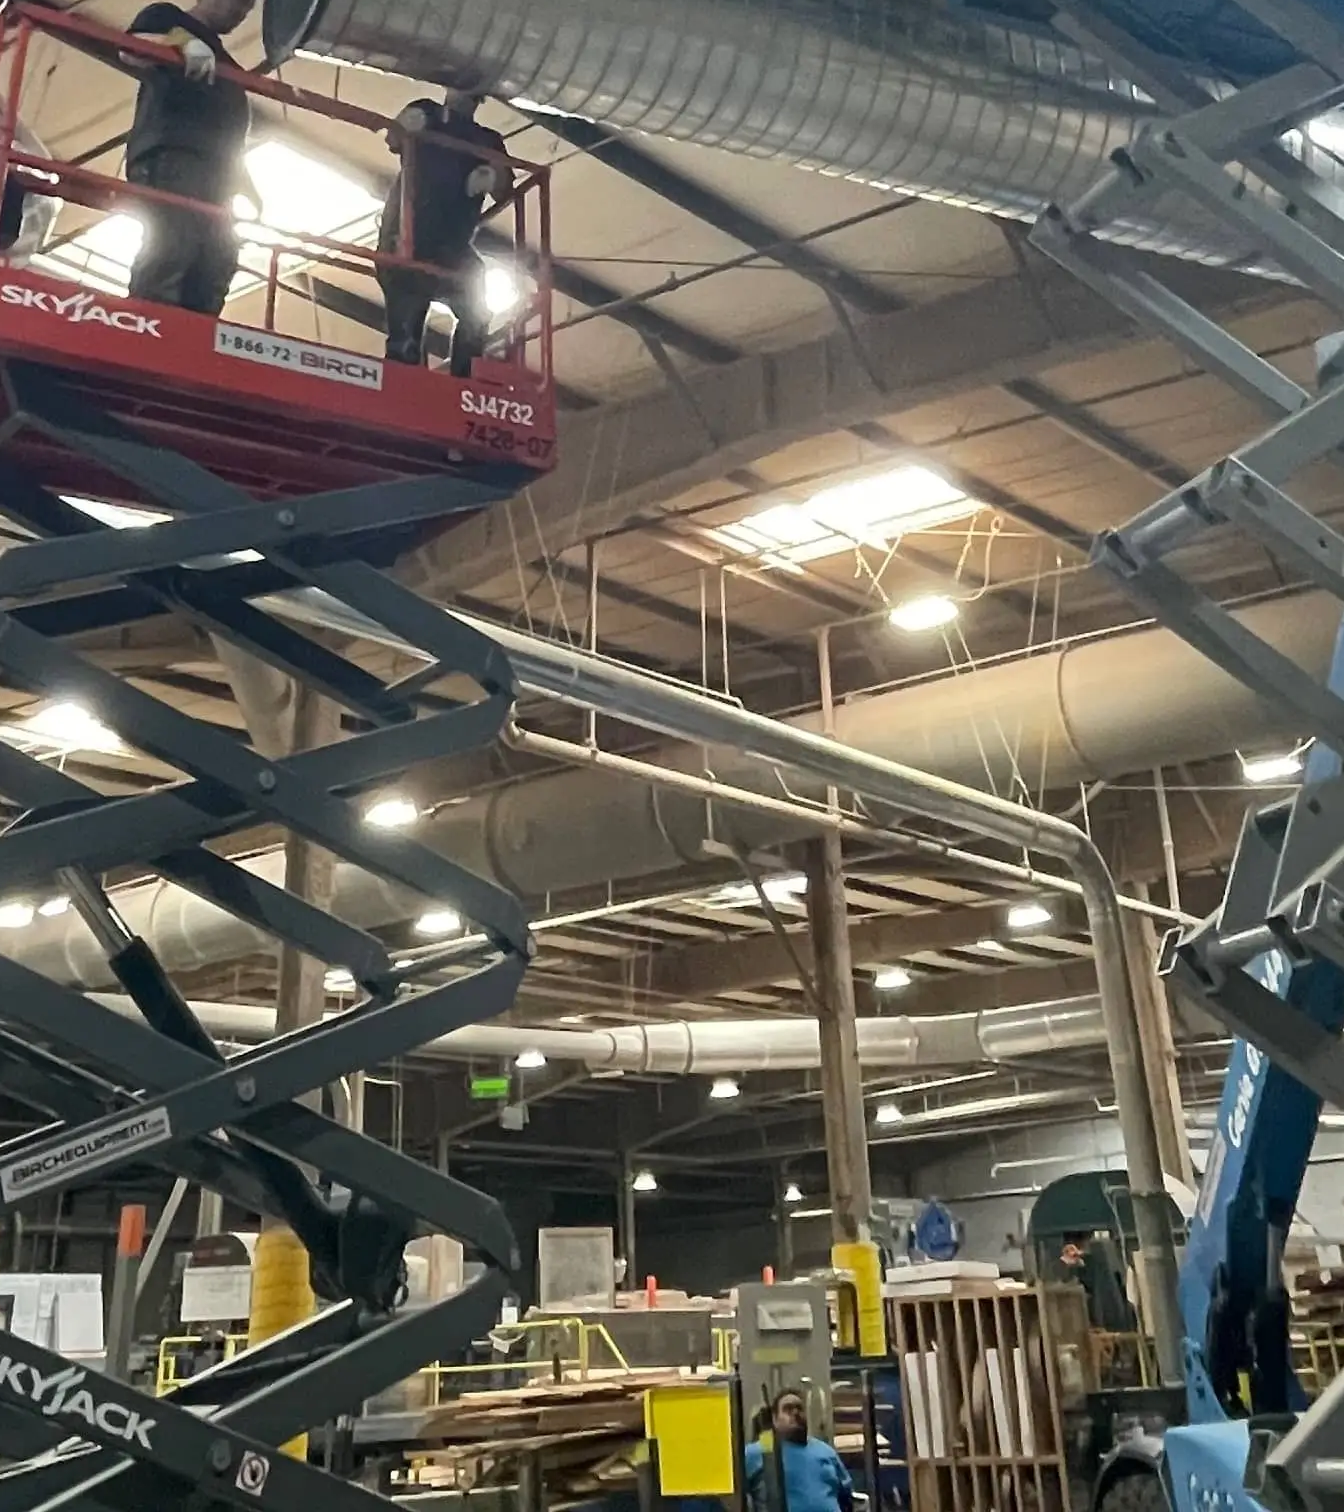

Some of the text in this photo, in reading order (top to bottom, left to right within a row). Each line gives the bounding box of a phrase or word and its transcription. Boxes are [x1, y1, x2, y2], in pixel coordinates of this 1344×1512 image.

[0, 284, 163, 339] SKYJACK
[220, 332, 378, 382] 1-866-72-BIRCH
[460, 390, 534, 426] SJ4732
